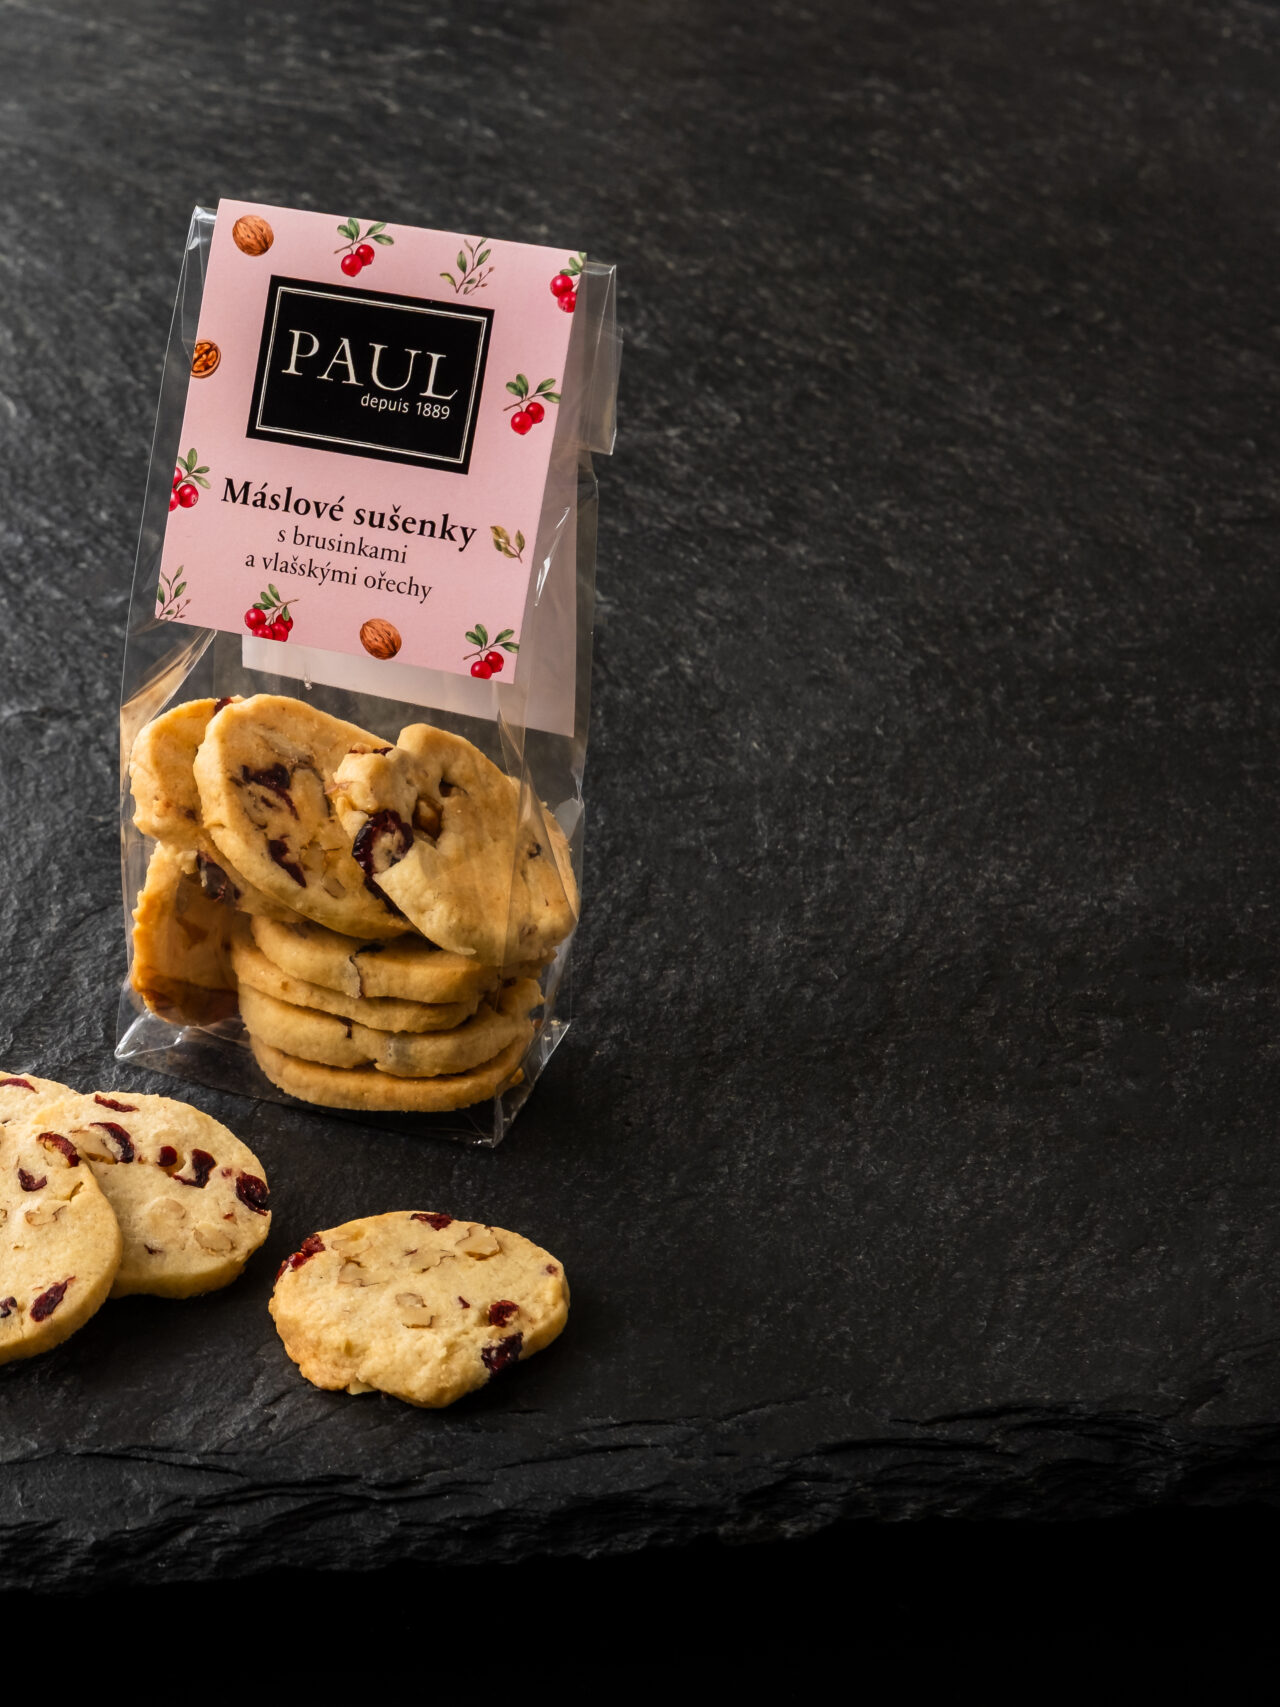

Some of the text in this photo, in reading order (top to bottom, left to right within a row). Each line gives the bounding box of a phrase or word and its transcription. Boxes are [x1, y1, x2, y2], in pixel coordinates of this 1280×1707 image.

[282, 329, 458, 400] PAUL
[360, 393, 451, 420] depuis 1889
[221, 477, 478, 552] Máslové sušenky
[277, 525, 408, 564] s brusinkami
[245, 552, 433, 604] a vlašskými ořechy
